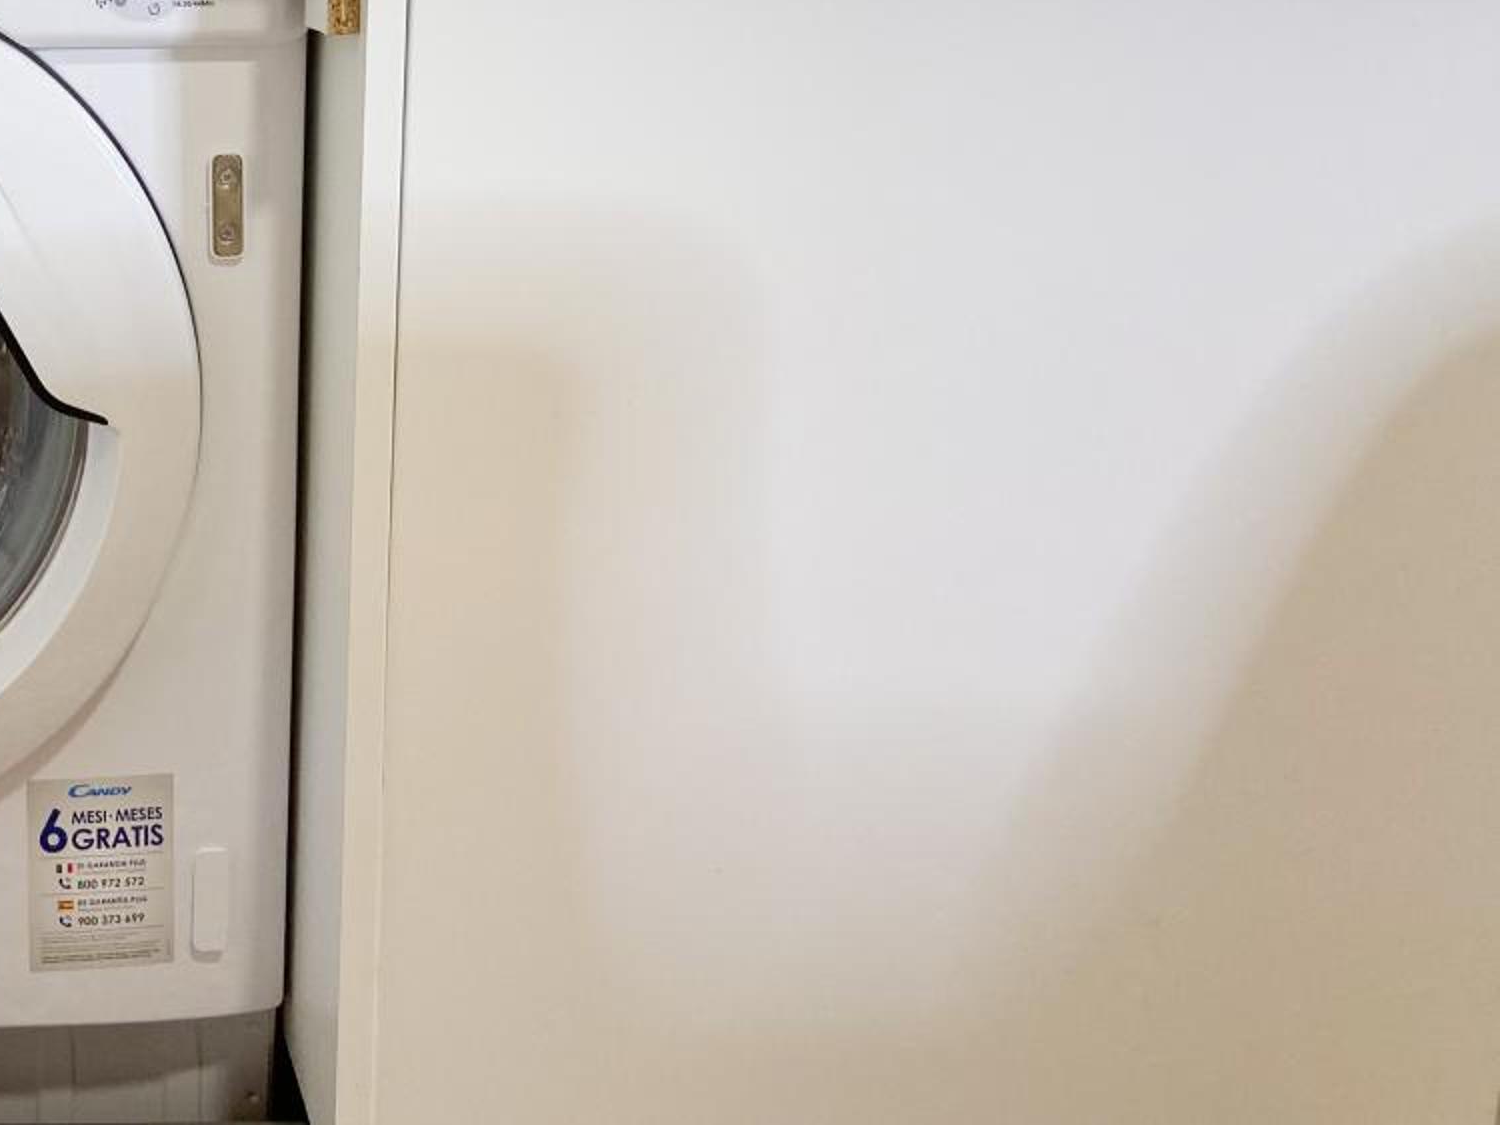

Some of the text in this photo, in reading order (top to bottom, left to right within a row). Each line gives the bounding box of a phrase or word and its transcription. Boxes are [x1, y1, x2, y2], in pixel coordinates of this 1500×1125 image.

[39, 806, 163, 853] 6 MESI MESES
[71, 824, 165, 851] GRATIS
